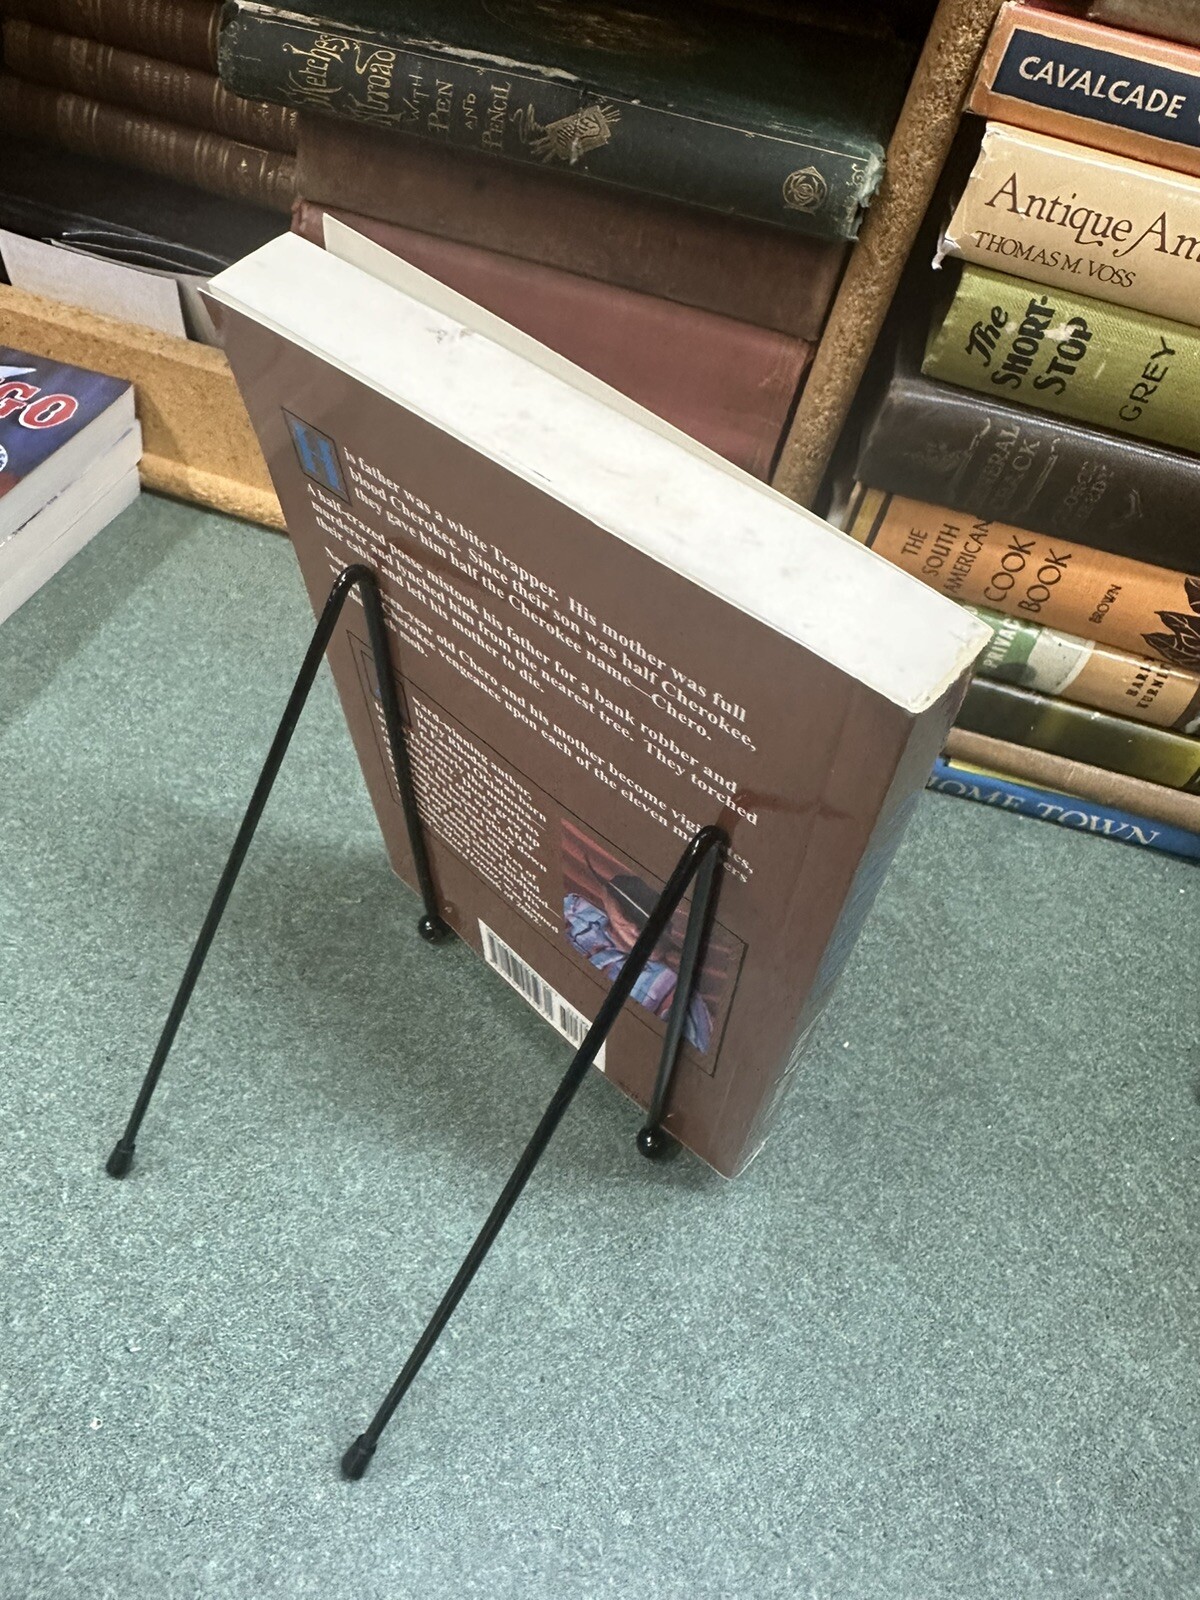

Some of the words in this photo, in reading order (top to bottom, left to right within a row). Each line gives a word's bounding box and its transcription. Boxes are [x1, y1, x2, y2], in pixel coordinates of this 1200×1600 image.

[1018, 56, 1187, 119] CAVALCADE
[985, 172, 1133, 247] Antique
[976, 230, 1060, 269] THOMAS
[1061, 257, 1083, 275] M.
[1089, 260, 1136, 288] VOSS
[965, 305, 1009, 367] The
[1033, 317, 1093, 396] STOP
[1119, 336, 1176, 422] GREY
[294, 424, 338, 488] H
[354, 487, 381, 515] they
[385, 510, 416, 537] gave
[418, 530, 446, 558] him
[449, 551, 478, 580] half
[481, 576, 504, 598] the
[508, 594, 581, 652] Cherokee
[901, 527, 929, 558] THE
[922, 523, 961, 577] SOUTH
[944, 519, 989, 595] AMERICAN
[983, 535, 1036, 602] COOK
[315, 516, 342, 541] their
[346, 539, 377, 567] cabin
[381, 565, 403, 587] and
[405, 581, 426, 604] left
[429, 598, 448, 620] his
[451, 618, 498, 657] mother
[502, 654, 515, 670] to
[519, 669, 544, 692] die.
[343, 446, 356, 464] is
[358, 457, 399, 492] father
[403, 489, 430, 514] was
[434, 510, 442, 522] a
[446, 518, 487, 552] white
[490, 544, 558, 600] Trapper.
[569, 597, 596, 626] His
[602, 623, 665, 669] mother
[670, 667, 706, 697] was
[712, 692, 745, 722] full
[348, 466, 386, 501] blood
[389, 495, 460, 551] Cherokee.
[468, 548, 507, 584] Since
[512, 579, 549, 610] their
[553, 609, 579, 634] son
[585, 631, 616, 658] was
[622, 652, 658, 684] half
[661, 680, 755, 750] Cherokee,
[1018, 548, 1072, 613] BOOK
[1089, 584, 1122, 624] BROWN
[307, 483, 316, 496] A
[317, 489, 385, 545] half-crazed
[388, 542, 422, 572] posse
[426, 570, 478, 613] mistook
[482, 607, 502, 630] his
[506, 626, 549, 663] father
[554, 660, 577, 682] for
[581, 682, 589, 694] a
[594, 688, 634, 725] bank
[640, 723, 698, 765] robber
[703, 766, 736, 793] and
[311, 501, 366, 544] murderer
[369, 543, 393, 565] and
[395, 560, 445, 603] lynched
[448, 597, 474, 625] him
[478, 620, 511, 652] from
[515, 649, 536, 671] the
[541, 669, 594, 713] nearest
[599, 710, 633, 741] tree.
[643, 739, 685, 775] They
[691, 773, 757, 824] torched
[399, 630, 427, 657] mob.
[382, 603, 435, 650] Cherokee
[438, 649, 500, 702] vengeance
[504, 700, 536, 730] upon
[541, 729, 571, 756] each
[575, 756, 591, 770] of
[594, 767, 616, 789] the
[620, 789, 667, 826] eleven
[429, 729, 470, 769] Eastern
[436, 634, 455, 653] old
[458, 650, 497, 685] Chero
[504, 686, 525, 708] and
[529, 703, 548, 725] his
[553, 724, 604, 764] mother
[609, 762, 666, 809] become
[414, 706, 444, 737] Dusty
[493, 775, 515, 796] was
[518, 794, 546, 822] born
[419, 731, 463, 773] formerly
[466, 772, 483, 789] the
[486, 790, 539, 836] notorious
[490, 762, 531, 800] author,
[436, 765, 452, 781] the
[455, 782, 471, 798] old
[505, 826, 533, 850] After
[448, 783, 478, 813] began
[481, 812, 514, 846] taking
[516, 845, 546, 872] down
[461, 776, 492, 806] Dusty
[495, 807, 521, 831] grew
[525, 832, 539, 847] up
[1037, 803, 1161, 845] TOWN
